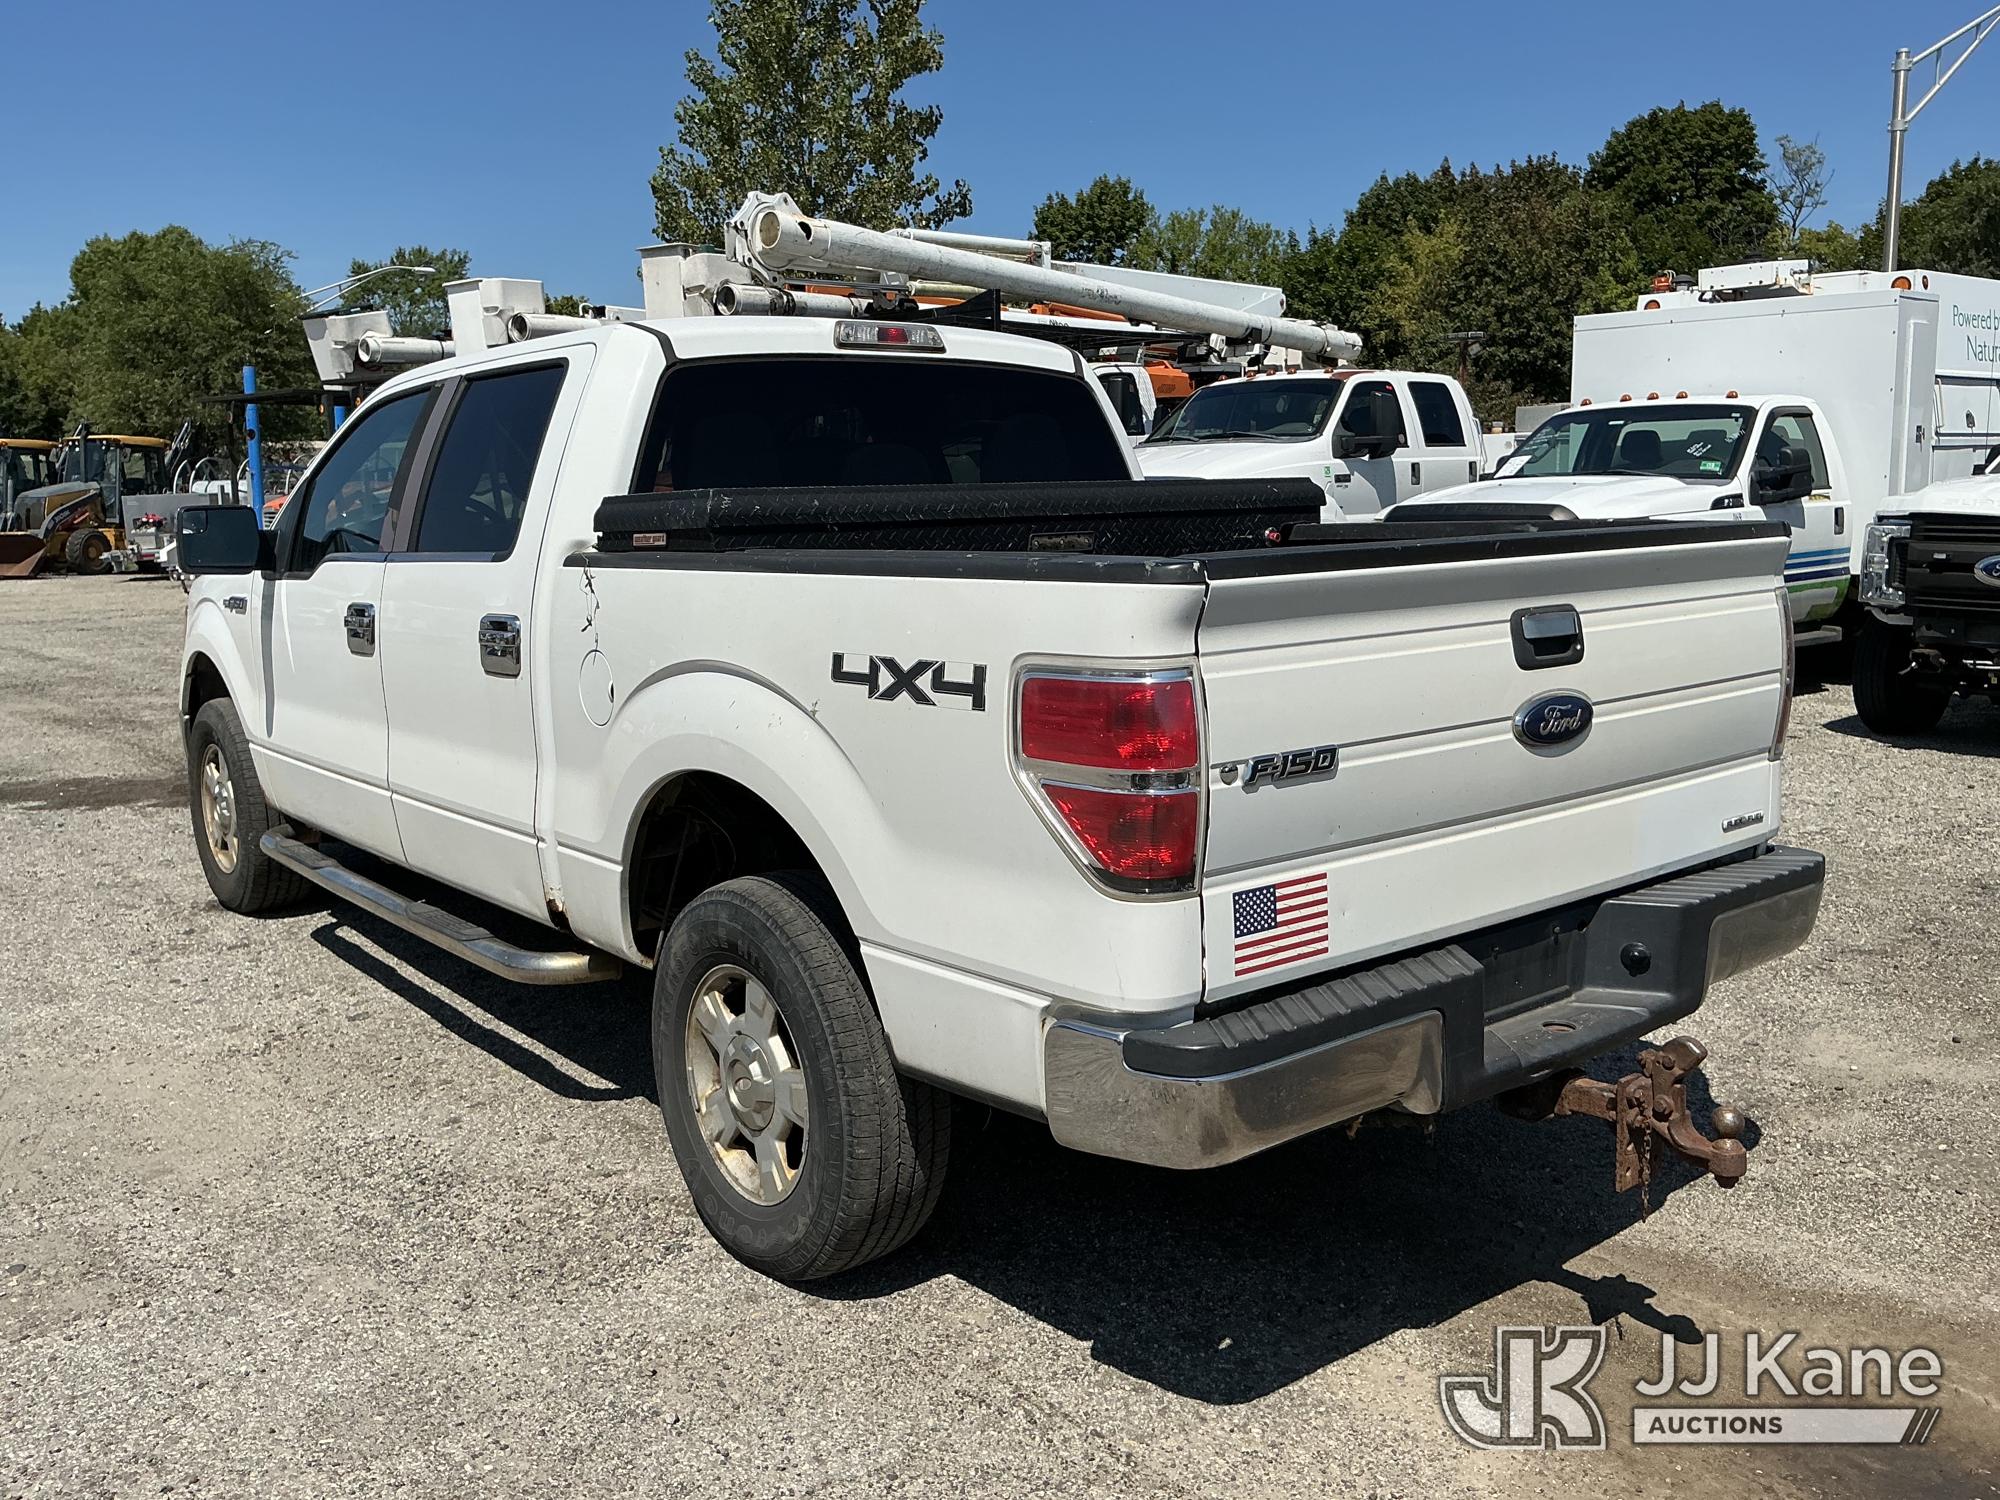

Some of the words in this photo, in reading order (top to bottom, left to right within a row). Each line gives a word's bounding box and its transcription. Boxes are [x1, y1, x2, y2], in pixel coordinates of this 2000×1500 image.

[1952, 304, 1992, 330] Powered
[1993, 309, 2000, 331] b
[1966, 334, 2000, 363] Natur
[830, 651, 988, 712] 4X4
[1540, 704, 1583, 736] Ford
[1244, 747, 1339, 785] F-150
